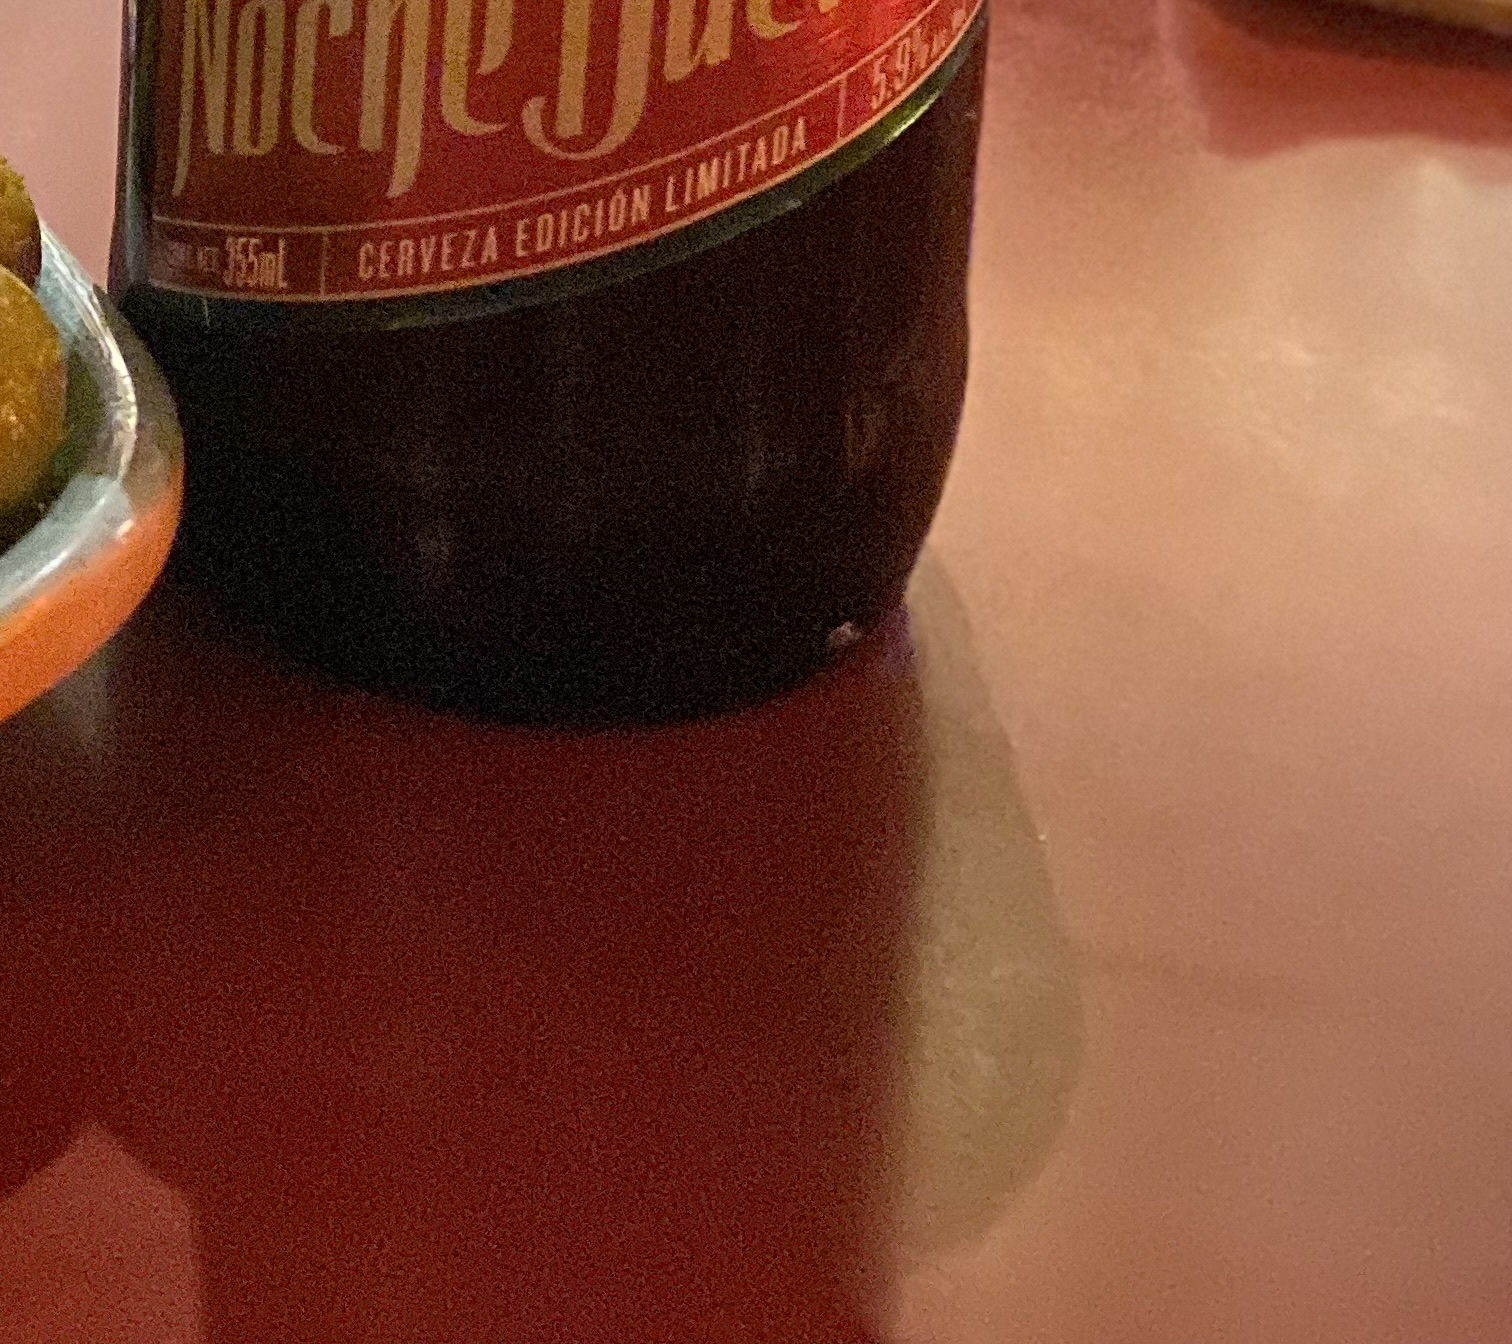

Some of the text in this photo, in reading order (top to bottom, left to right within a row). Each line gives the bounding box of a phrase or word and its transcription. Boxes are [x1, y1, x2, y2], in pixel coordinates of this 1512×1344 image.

[358, 116, 806, 281] CERVEZA EDICIÓN LIMITADA
